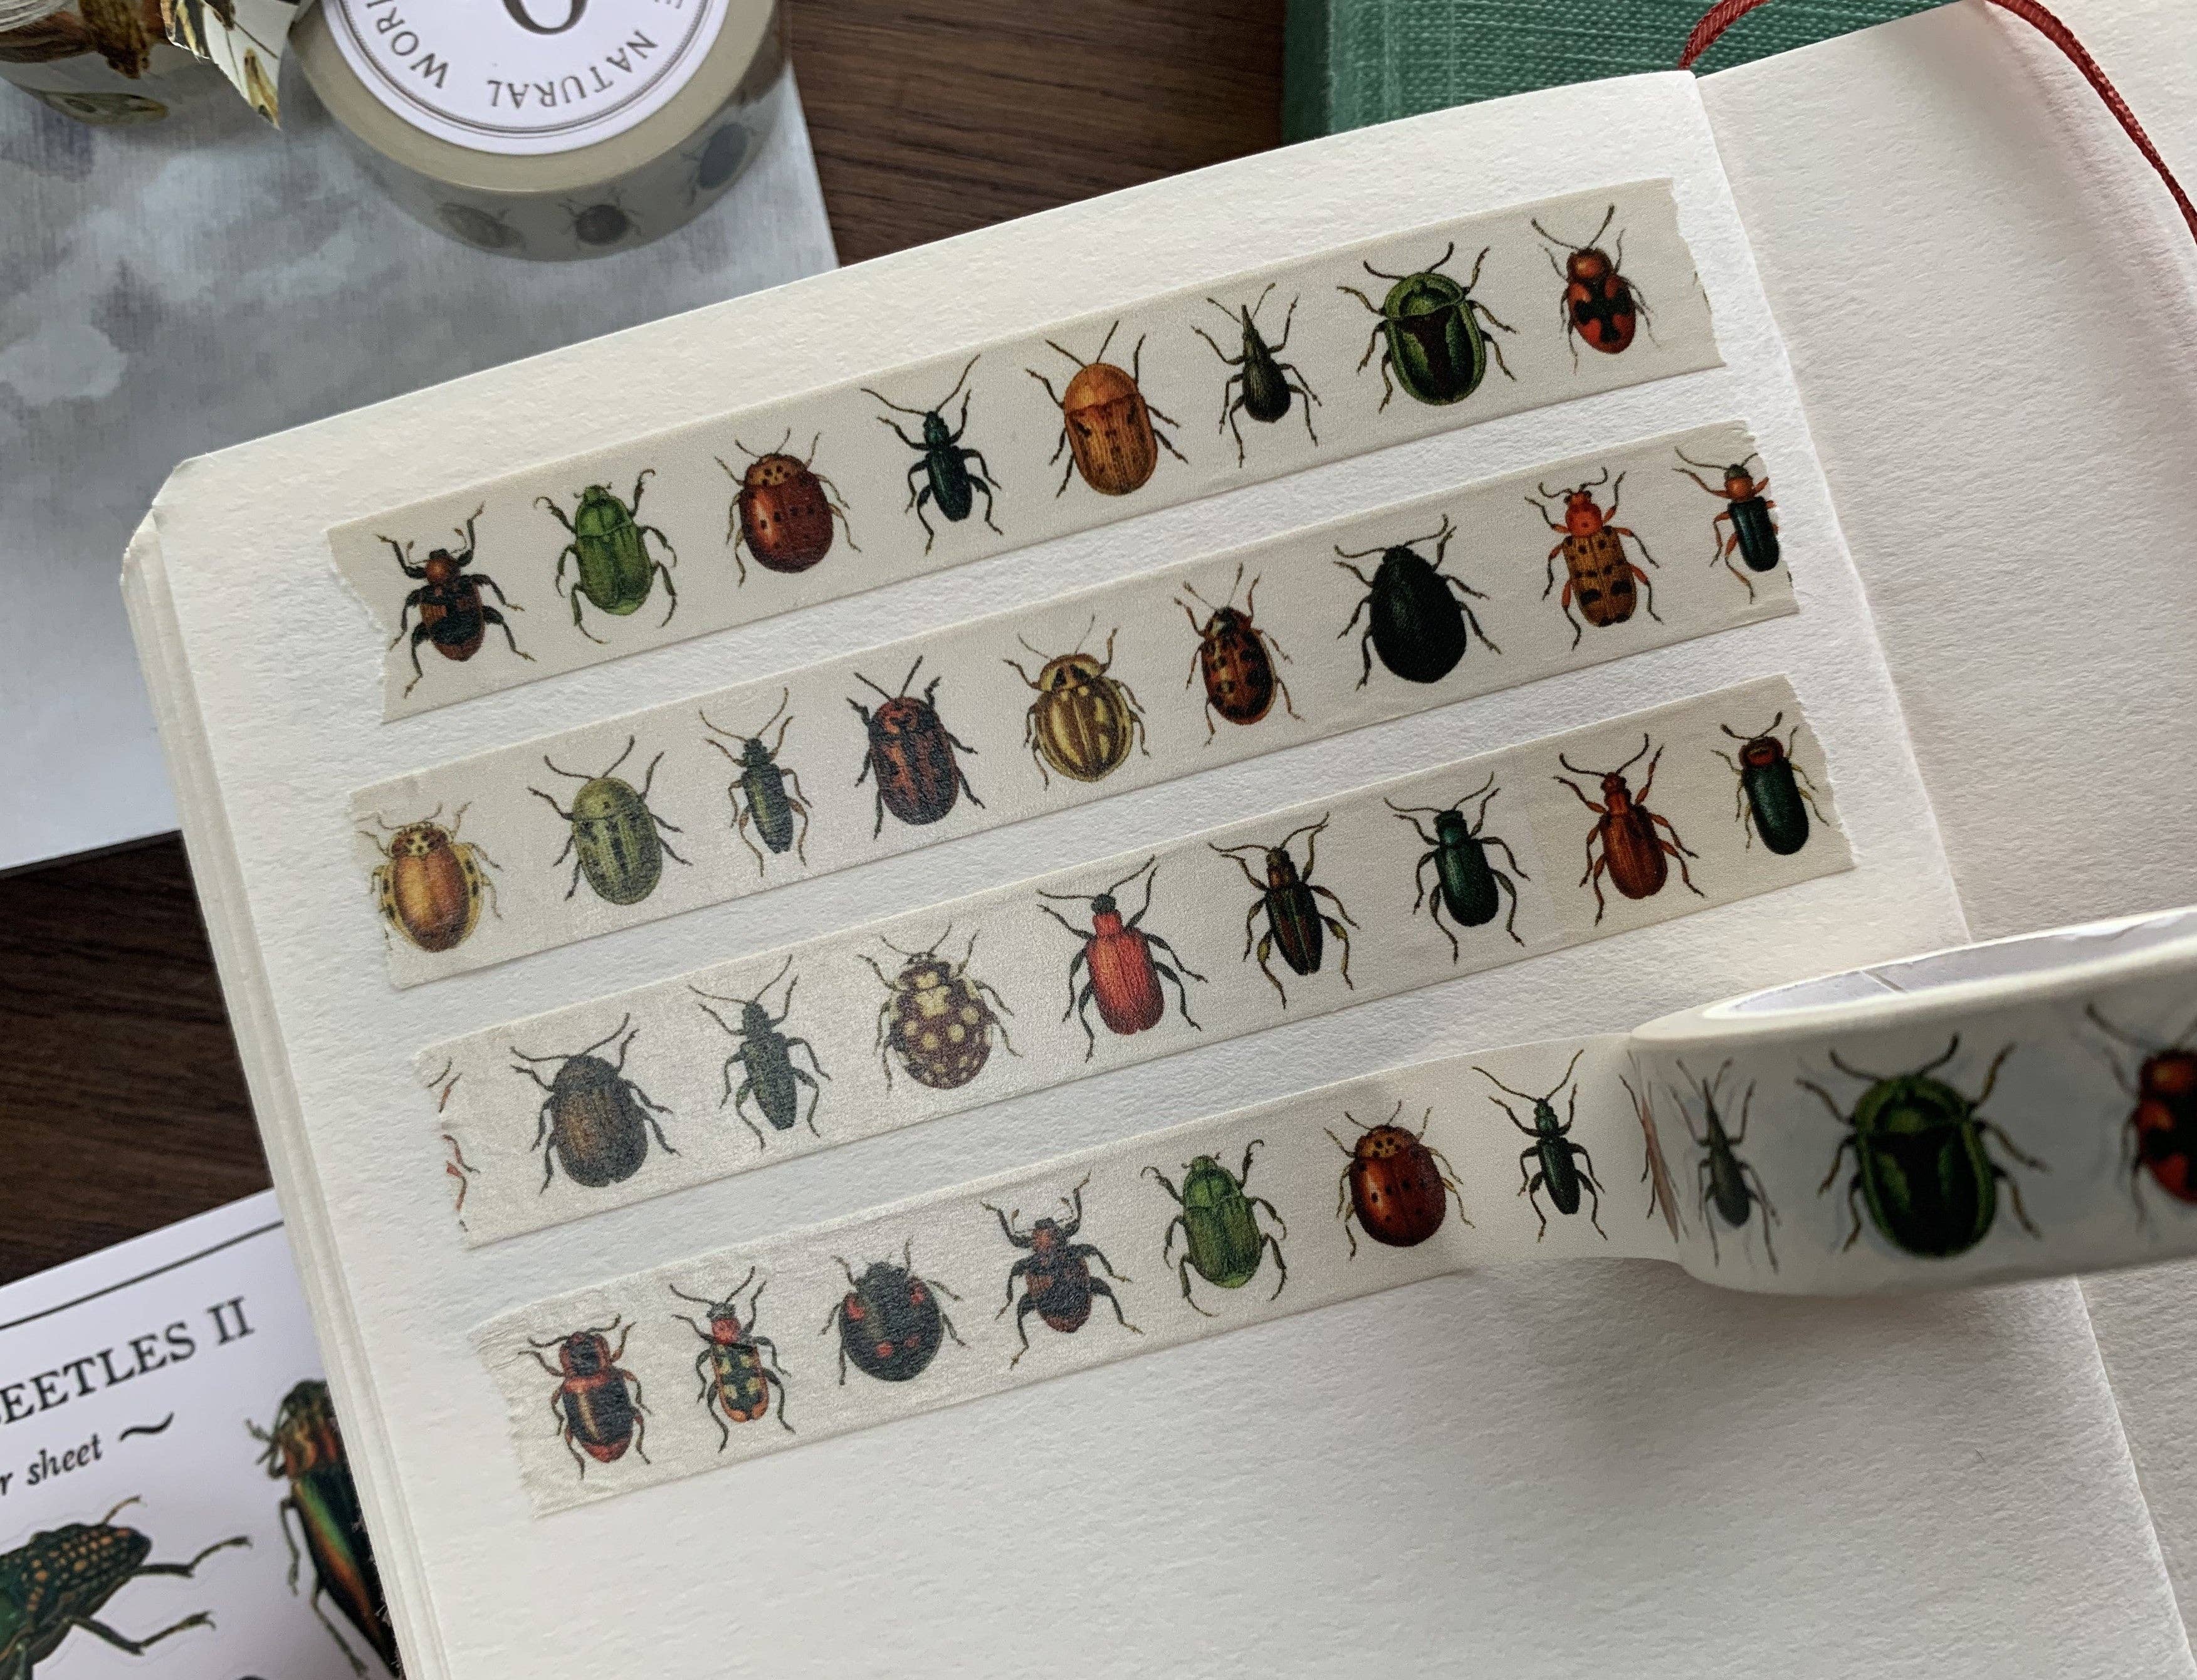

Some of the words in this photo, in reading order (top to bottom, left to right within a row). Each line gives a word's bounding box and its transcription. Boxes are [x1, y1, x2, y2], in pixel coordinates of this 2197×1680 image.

[486, 30, 658, 108] NATURAL
[0, 1320, 196, 1424] EETLES
[207, 1295, 255, 1345] II
[27, 1432, 102, 1486] sheet
